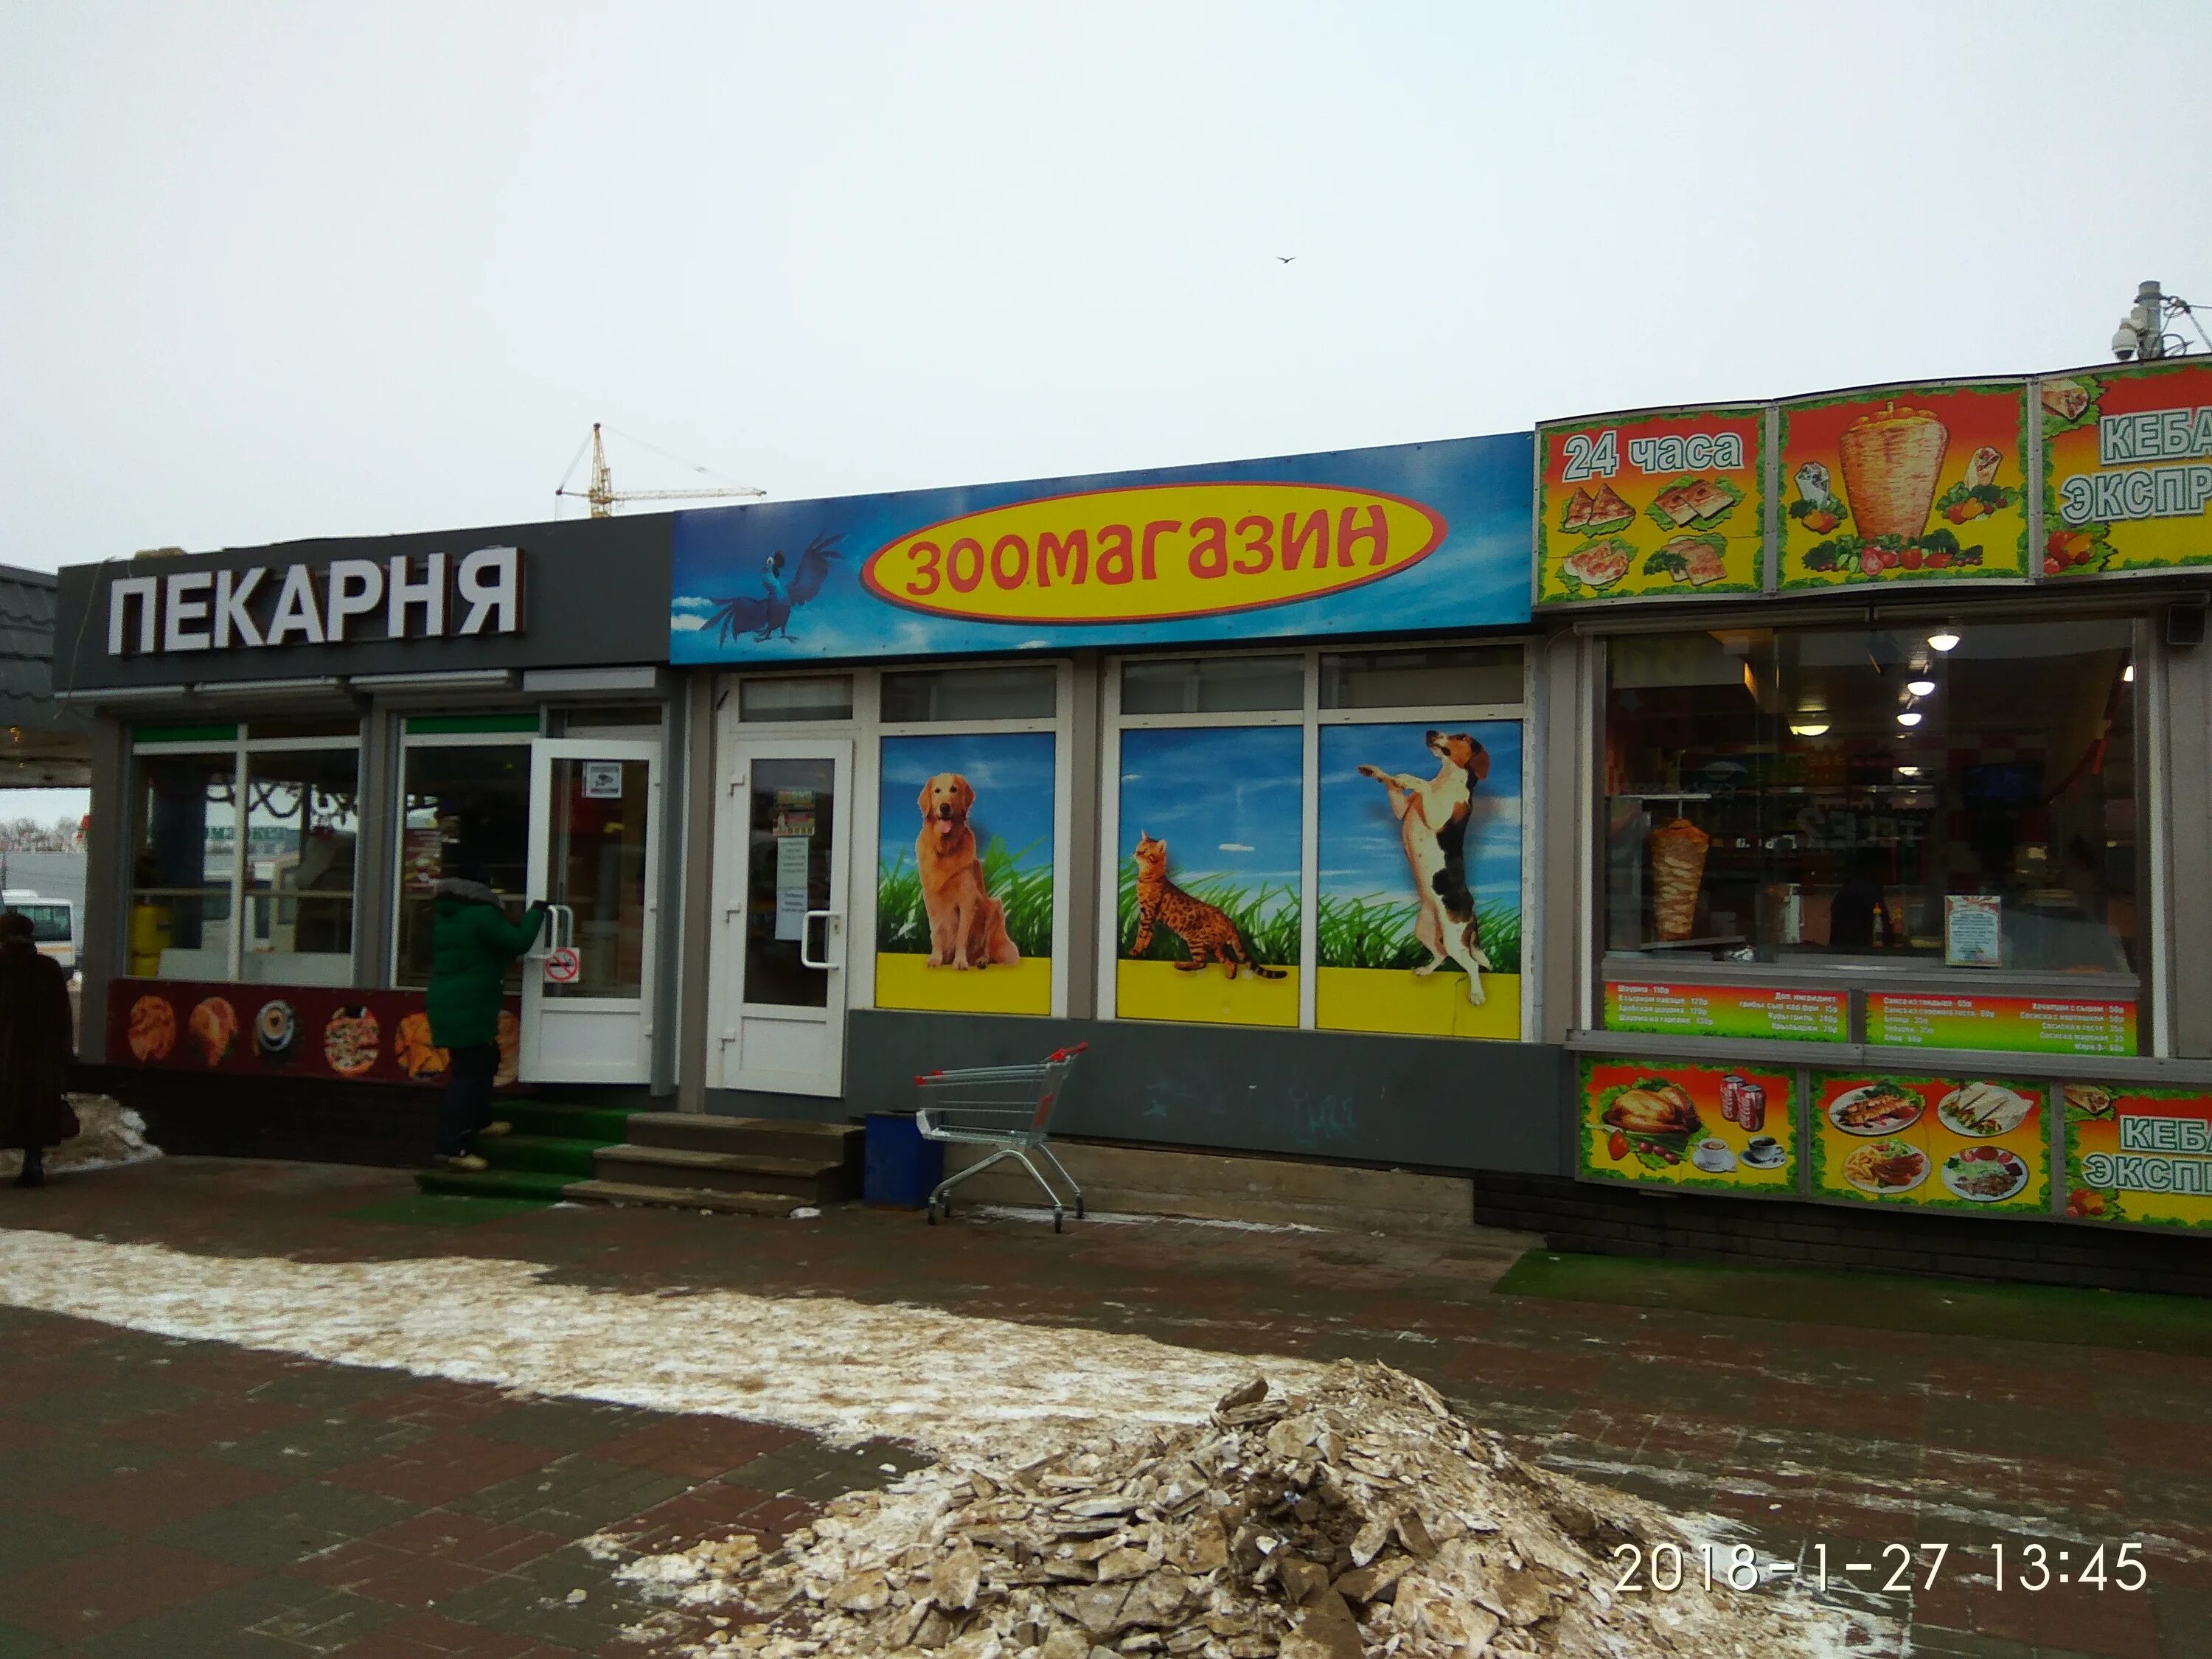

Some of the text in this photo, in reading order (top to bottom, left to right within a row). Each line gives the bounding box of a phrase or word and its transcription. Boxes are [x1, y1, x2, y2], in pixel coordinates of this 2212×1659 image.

[1562, 431, 1745, 483] 24 часа
[2060, 464, 2212, 524] ЭКСПР
[108, 546, 525, 655] ПЕКАРНЯ
[2120, 1115, 2212, 1155] КЕБ
[2082, 1151, 2212, 1196] ЭКСП
